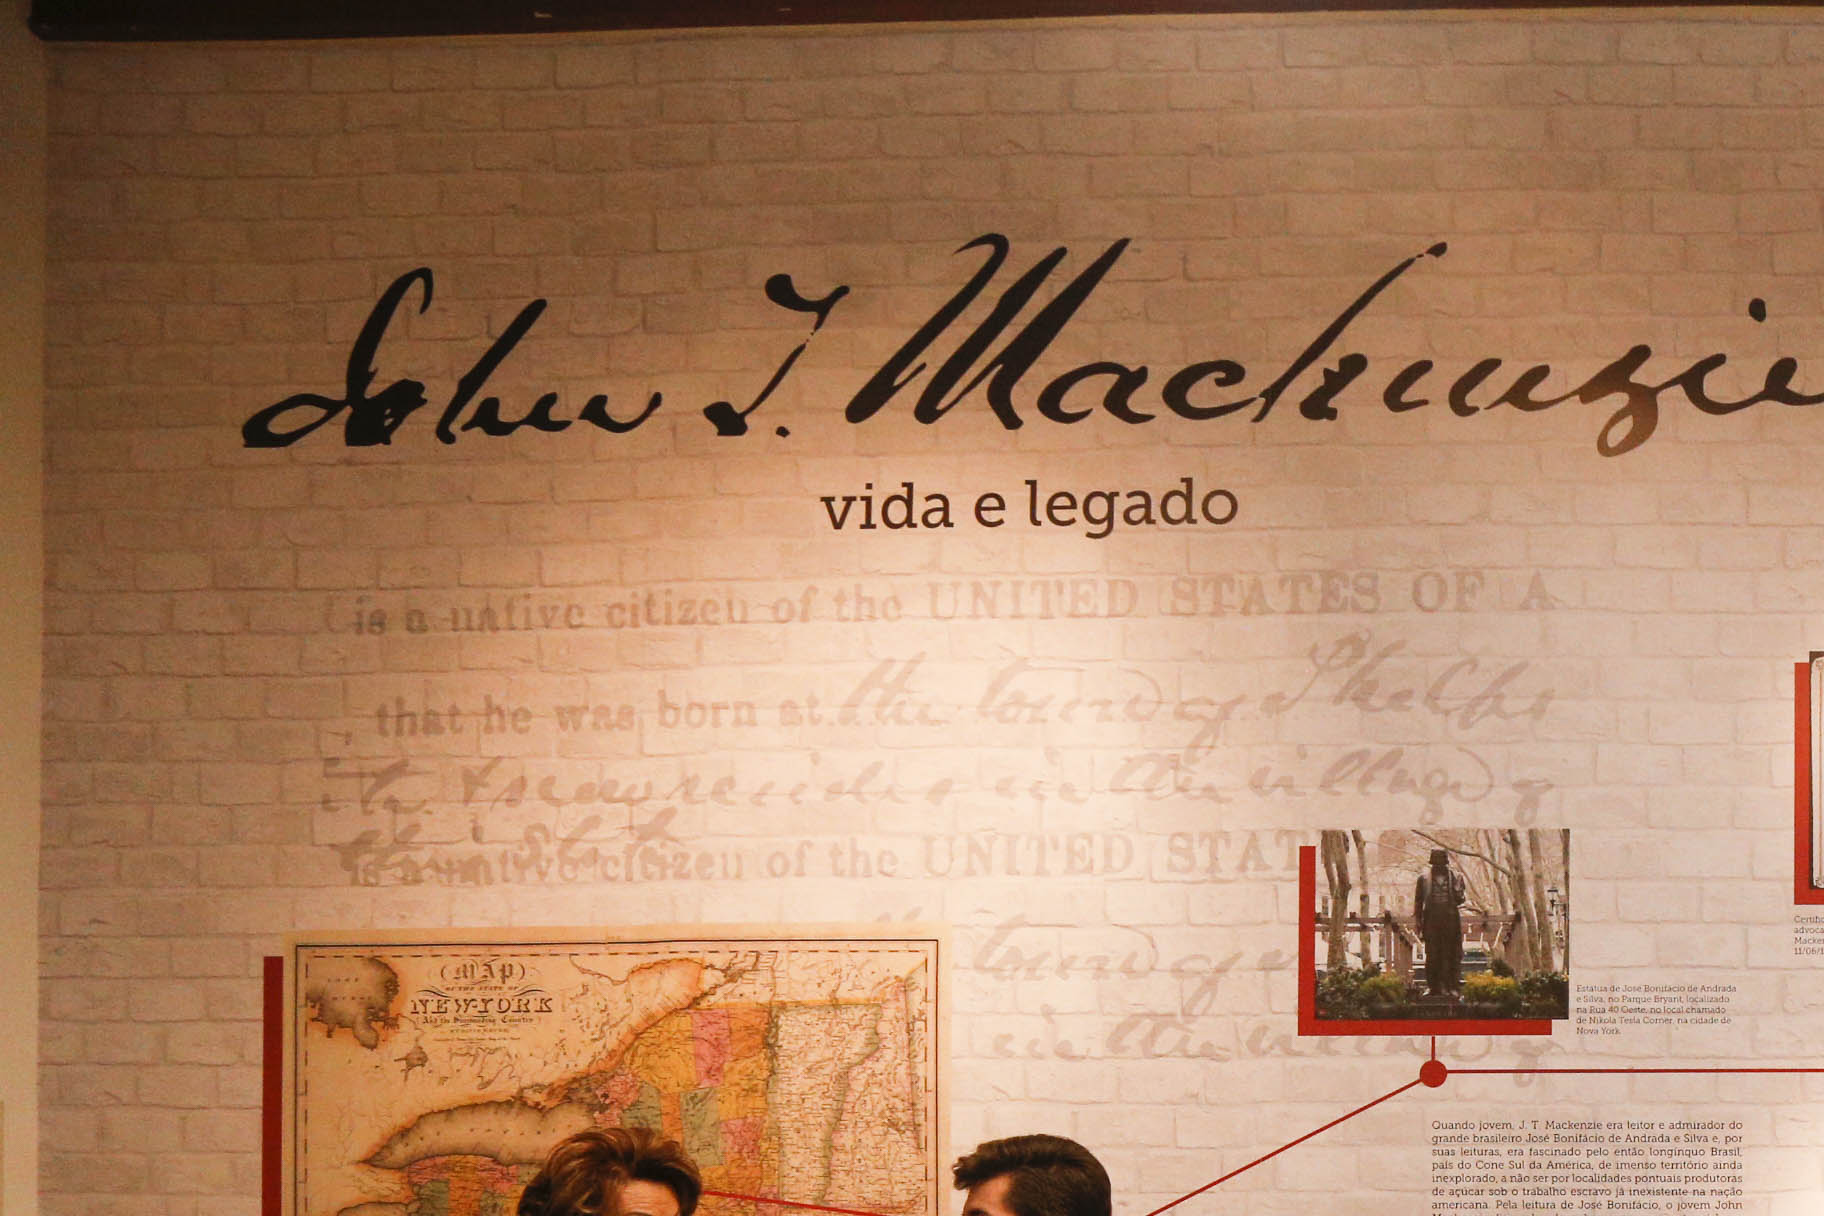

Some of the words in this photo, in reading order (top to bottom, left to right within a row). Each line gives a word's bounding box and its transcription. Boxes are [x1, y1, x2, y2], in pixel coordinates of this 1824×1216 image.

[821, 481, 955, 531] vida
[973, 491, 1007, 529] e
[1025, 478, 1241, 540] legado
[354, 596, 387, 636] is
[405, 606, 430, 634] a
[450, 593, 585, 632] native
[605, 588, 751, 630] citizen
[773, 582, 812, 624] of
[834, 584, 901, 622] the
[928, 577, 1138, 620] UNITED
[1168, 568, 1383, 618] STATES
[1411, 569, 1486, 614] OF
[1519, 569, 1558, 612] A
[376, 697, 462, 738] that
[483, 694, 532, 736] he
[556, 701, 636, 732] was
[657, 690, 758, 728] born
[1432, 1173, 1499, 1185] inexplorado,
[1500, 1175, 1507, 1183] a
[1510, 1173, 1530, 1183] não
[1532, 1175, 1548, 1183] ser
[1551, 1175, 1569, 1185] por
[1572, 1173, 1632, 1183] localidades
[1634, 1173, 1682, 1185] pontuais
[1684, 1173, 1743, 1185] produtoras
